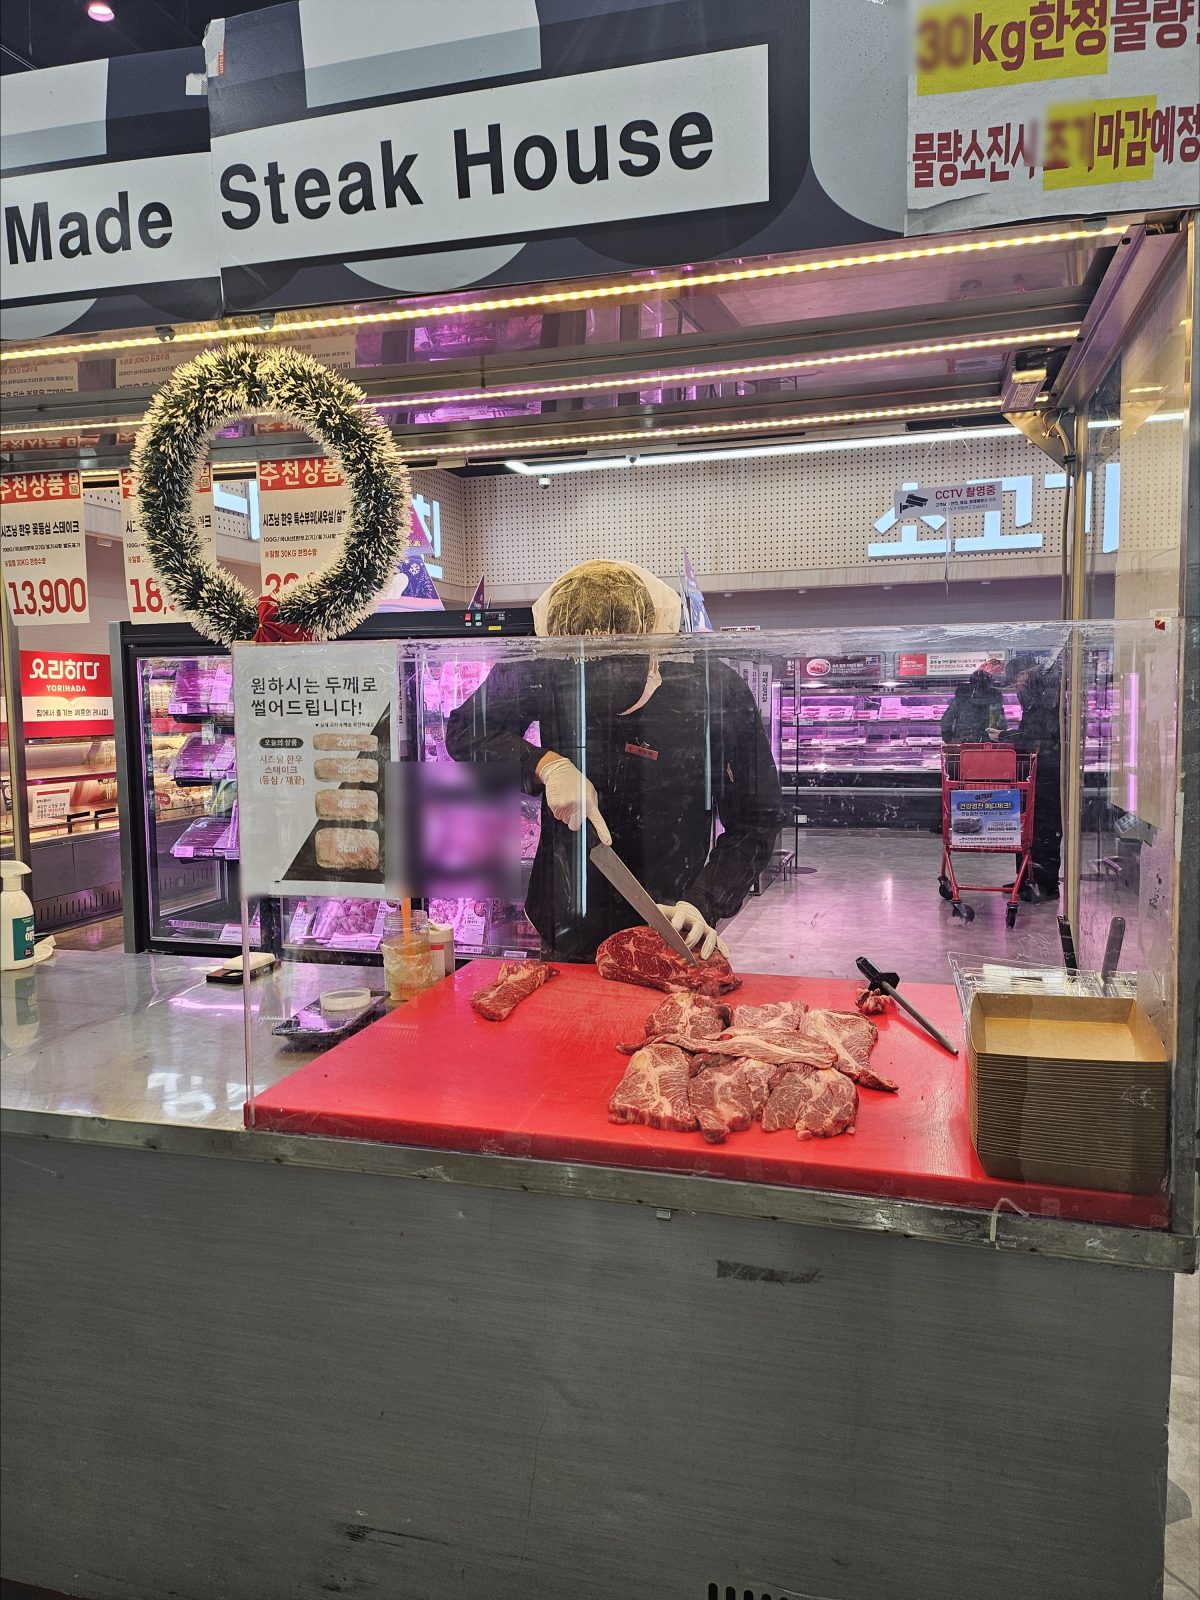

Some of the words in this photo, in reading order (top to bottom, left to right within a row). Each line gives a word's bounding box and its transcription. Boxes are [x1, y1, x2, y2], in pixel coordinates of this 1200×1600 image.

[5, 191, 173, 265] Made
[220, 140, 424, 231] Steak
[453, 112, 714, 197] House
[260, 459, 342, 487] 추천상품
[935, 489, 963, 499] CCTV
[966, 484, 996, 498] 촬영중
[281, 513, 292, 527] 한우
[19, 524, 31, 537] 한우
[32, 522, 51, 536] 꽃등심
[53, 520, 79, 534] 스테이크
[8, 577, 87, 616] 13,900
[29, 658, 100, 680] 요리하다
[46, 684, 87, 692] YORIHADA
[251, 676, 320, 695] 원하시는
[325, 676, 378, 694] 두께로
[251, 698, 362, 717] 썰어드립니다!
[264, 739, 284, 747] 오늘의
[336, 736, 356, 748] 2cm
[260, 754, 283, 765] 시즈닝
[287, 754, 304, 765] 한우
[265, 766, 297, 775] 스테이크
[337, 763, 357, 774] 3cm
[337, 799, 358, 810] 4cm
